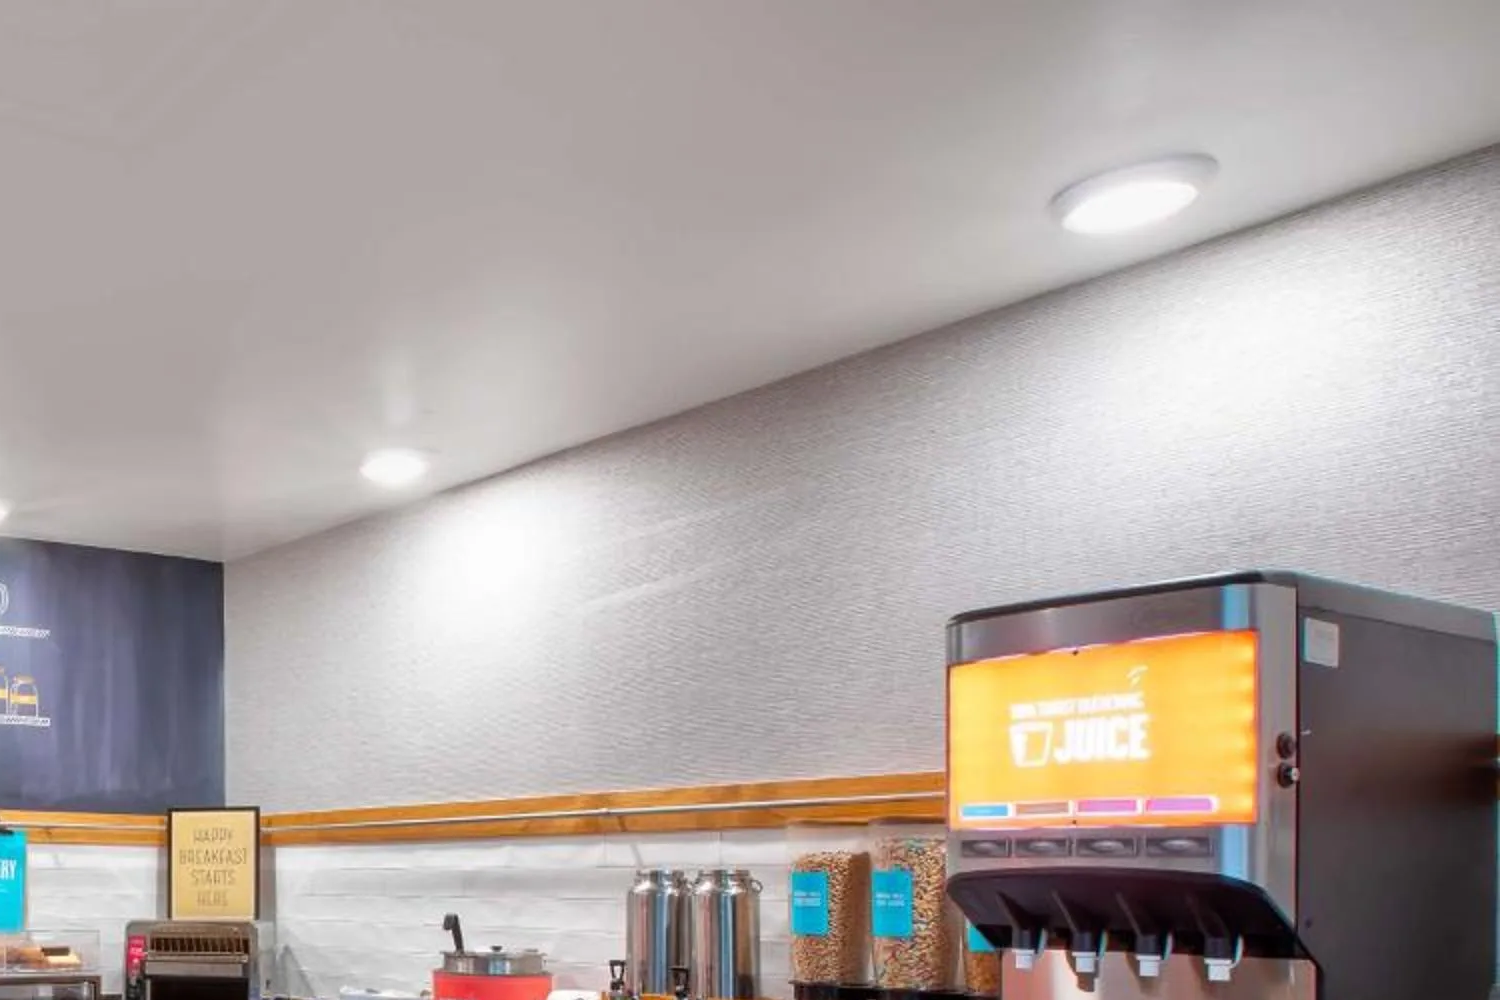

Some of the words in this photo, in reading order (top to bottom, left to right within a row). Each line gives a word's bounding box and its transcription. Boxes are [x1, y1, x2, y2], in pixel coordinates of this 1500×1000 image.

[1053, 713, 1151, 763] JUICE
[192, 826, 235, 845] HAPPY
[179, 847, 248, 866] BREAKFAST
[191, 868, 236, 886] STARTS
